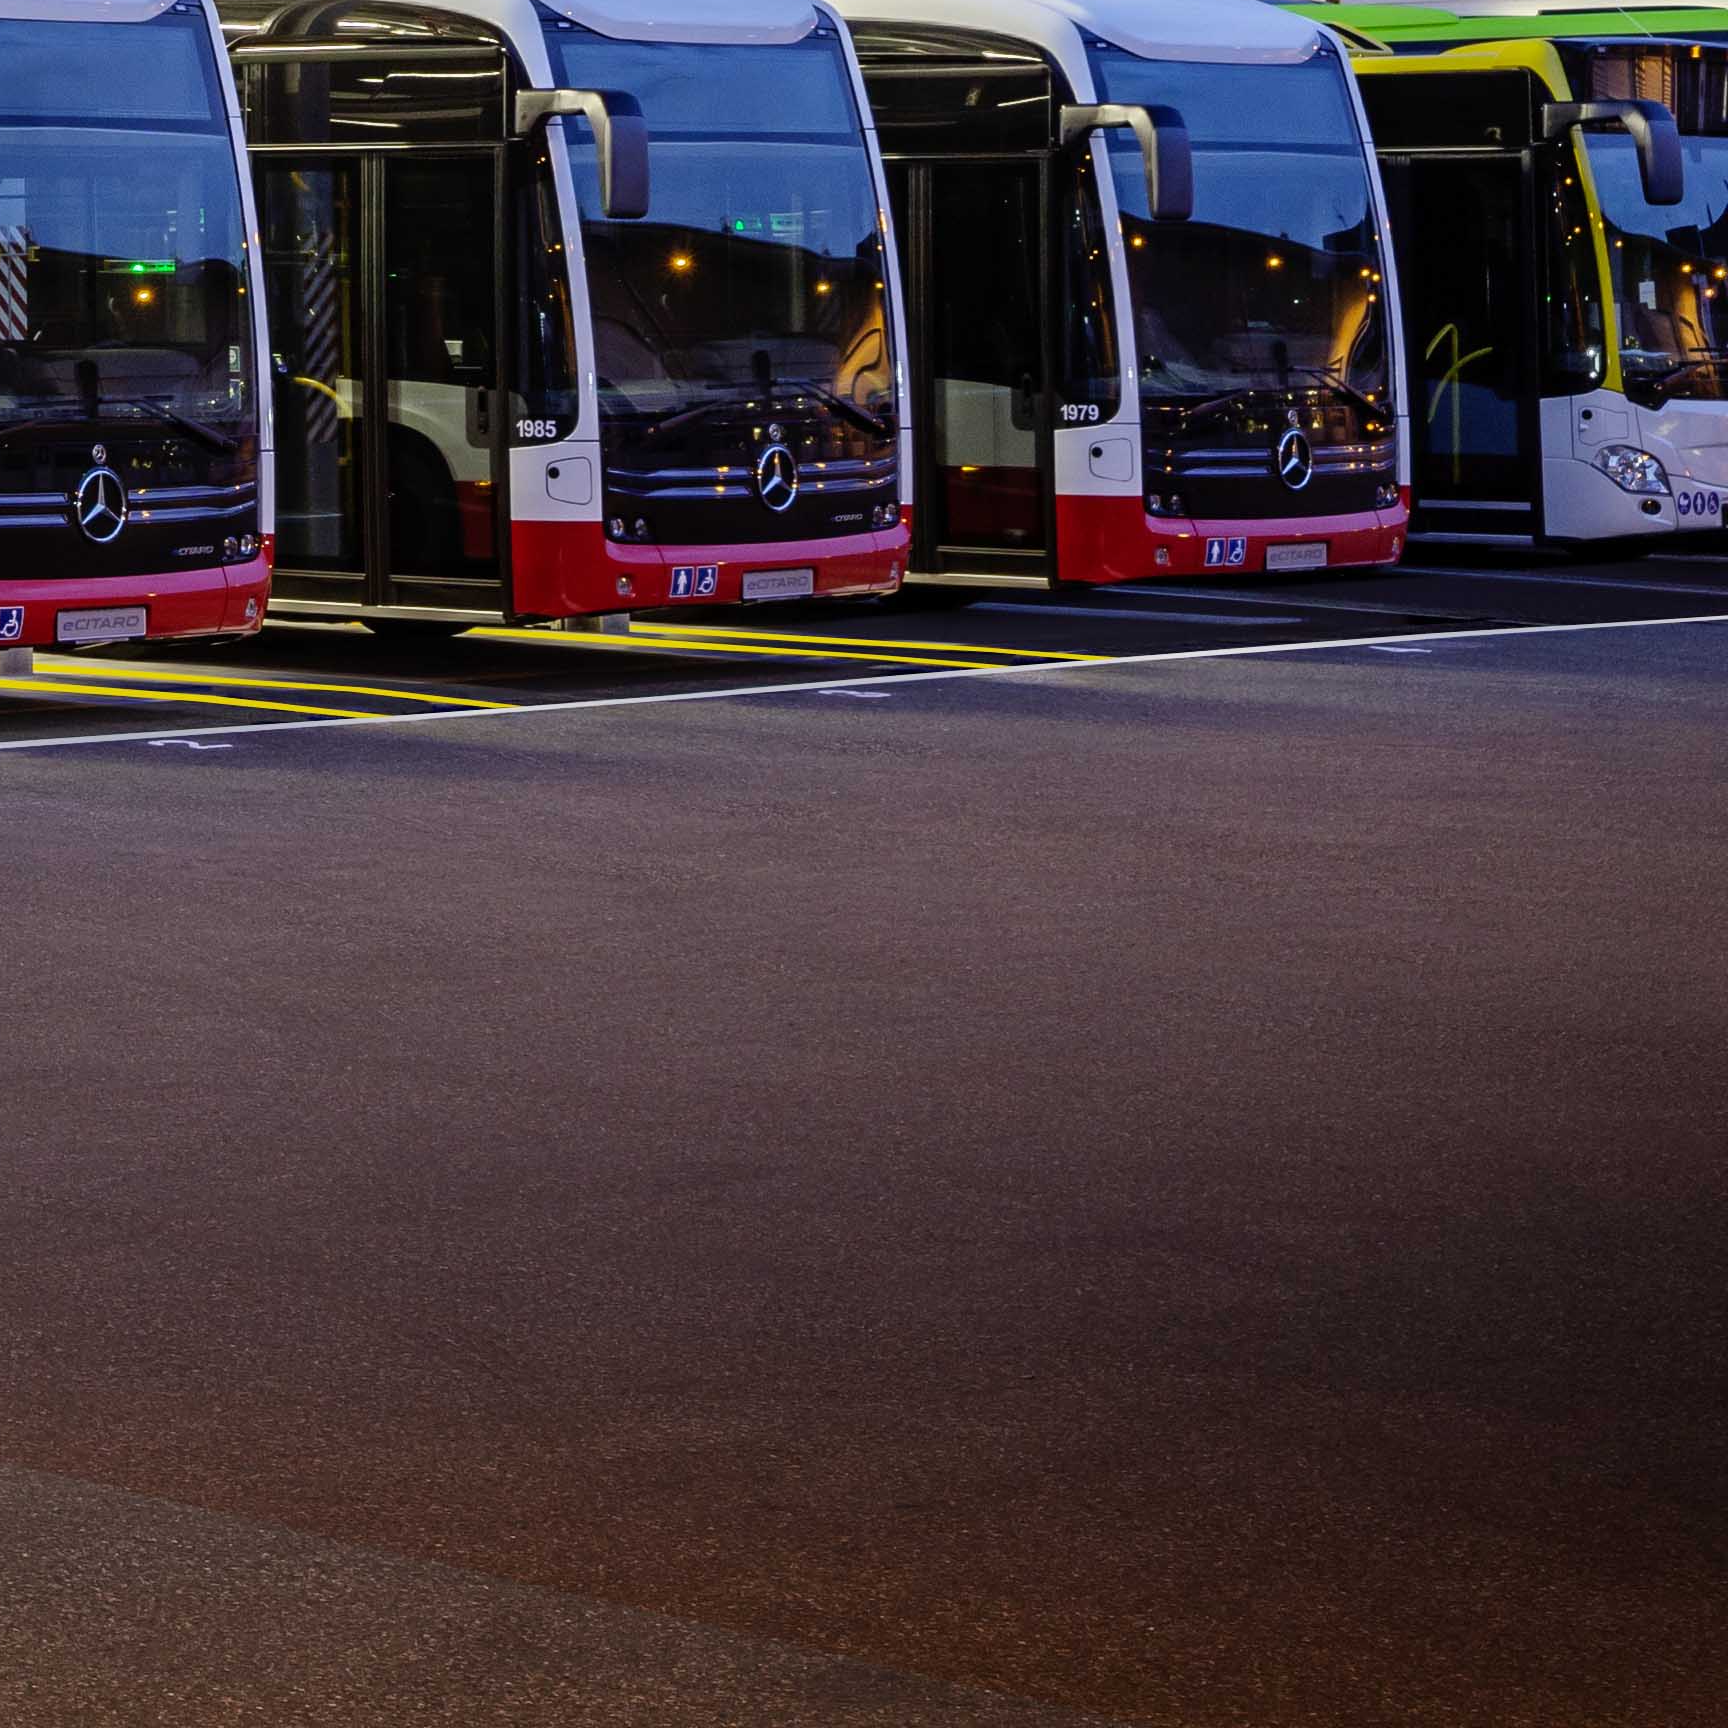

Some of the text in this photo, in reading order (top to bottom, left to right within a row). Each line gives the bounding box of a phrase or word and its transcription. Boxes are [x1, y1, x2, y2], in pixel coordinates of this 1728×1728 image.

[1060, 404, 1099, 421] 1979
[516, 419, 557, 438] 1985
[63, 615, 140, 631] eCITARO
